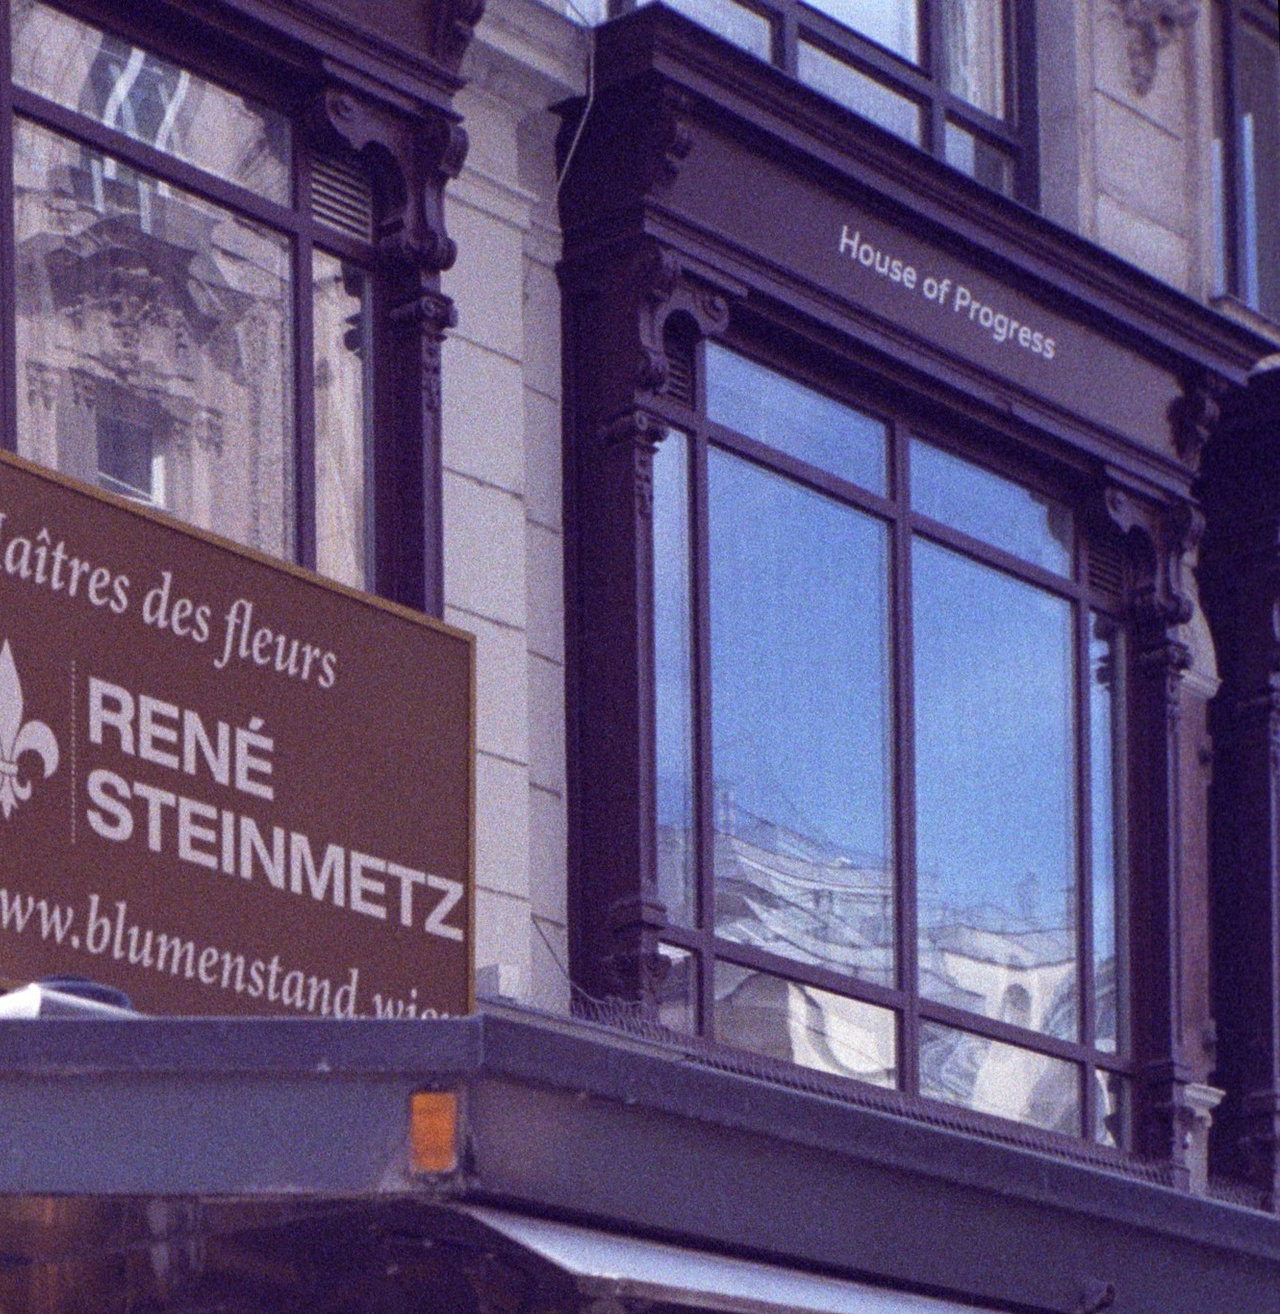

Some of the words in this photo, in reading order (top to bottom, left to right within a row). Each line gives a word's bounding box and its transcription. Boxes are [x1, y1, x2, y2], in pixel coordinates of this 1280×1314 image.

[839, 225, 918, 290] House
[922, 277, 952, 305] of
[953, 285, 1057, 360] Progress
[141, 570, 213, 645] des
[213, 597, 338, 690] fleurs
[87, 675, 276, 801] RENÉ
[85, 767, 466, 943] STEINMETZ
